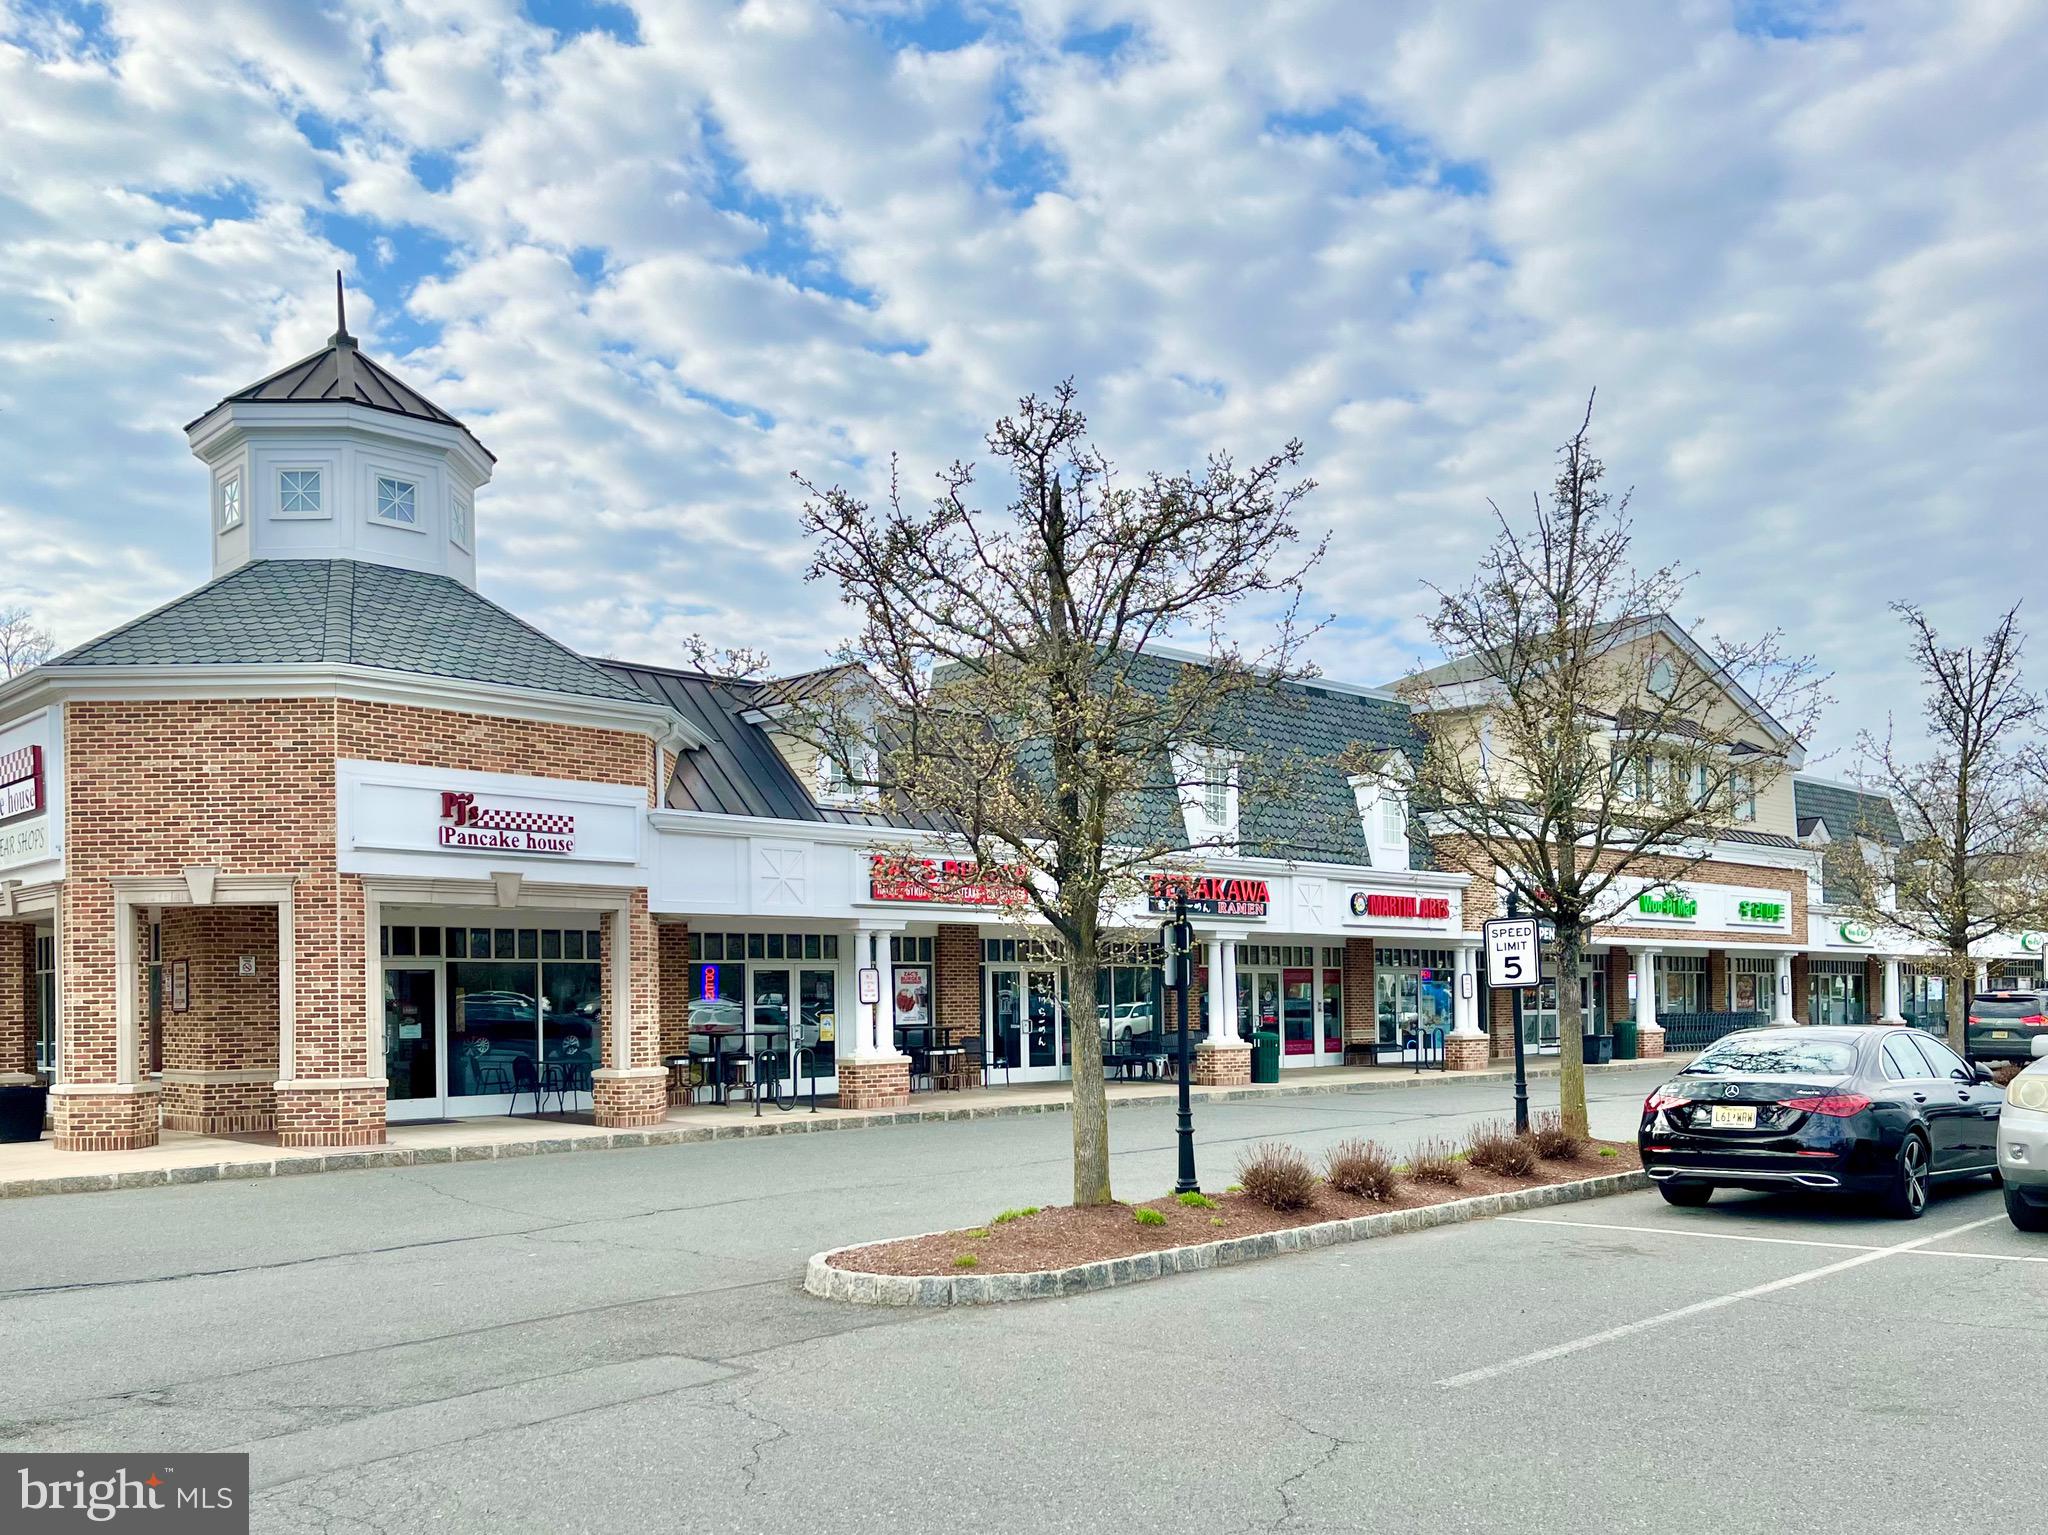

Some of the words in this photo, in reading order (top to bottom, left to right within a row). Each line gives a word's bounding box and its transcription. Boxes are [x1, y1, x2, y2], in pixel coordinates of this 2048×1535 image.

[7, 787, 35, 814] house
[17, 827, 45, 854] SHOPS
[444, 826, 520, 848] Pancake
[527, 832, 574, 852] house
[1217, 901, 1264, 915] RAMEN
[1368, 895, 1417, 918] MARTIAL
[1420, 898, 1449, 919] ARTS
[1491, 927, 1532, 938] SPEED
[1538, 927, 1556, 940] PEN
[1496, 941, 1527, 951] LIMIT
[1504, 956, 1522, 979] 5
